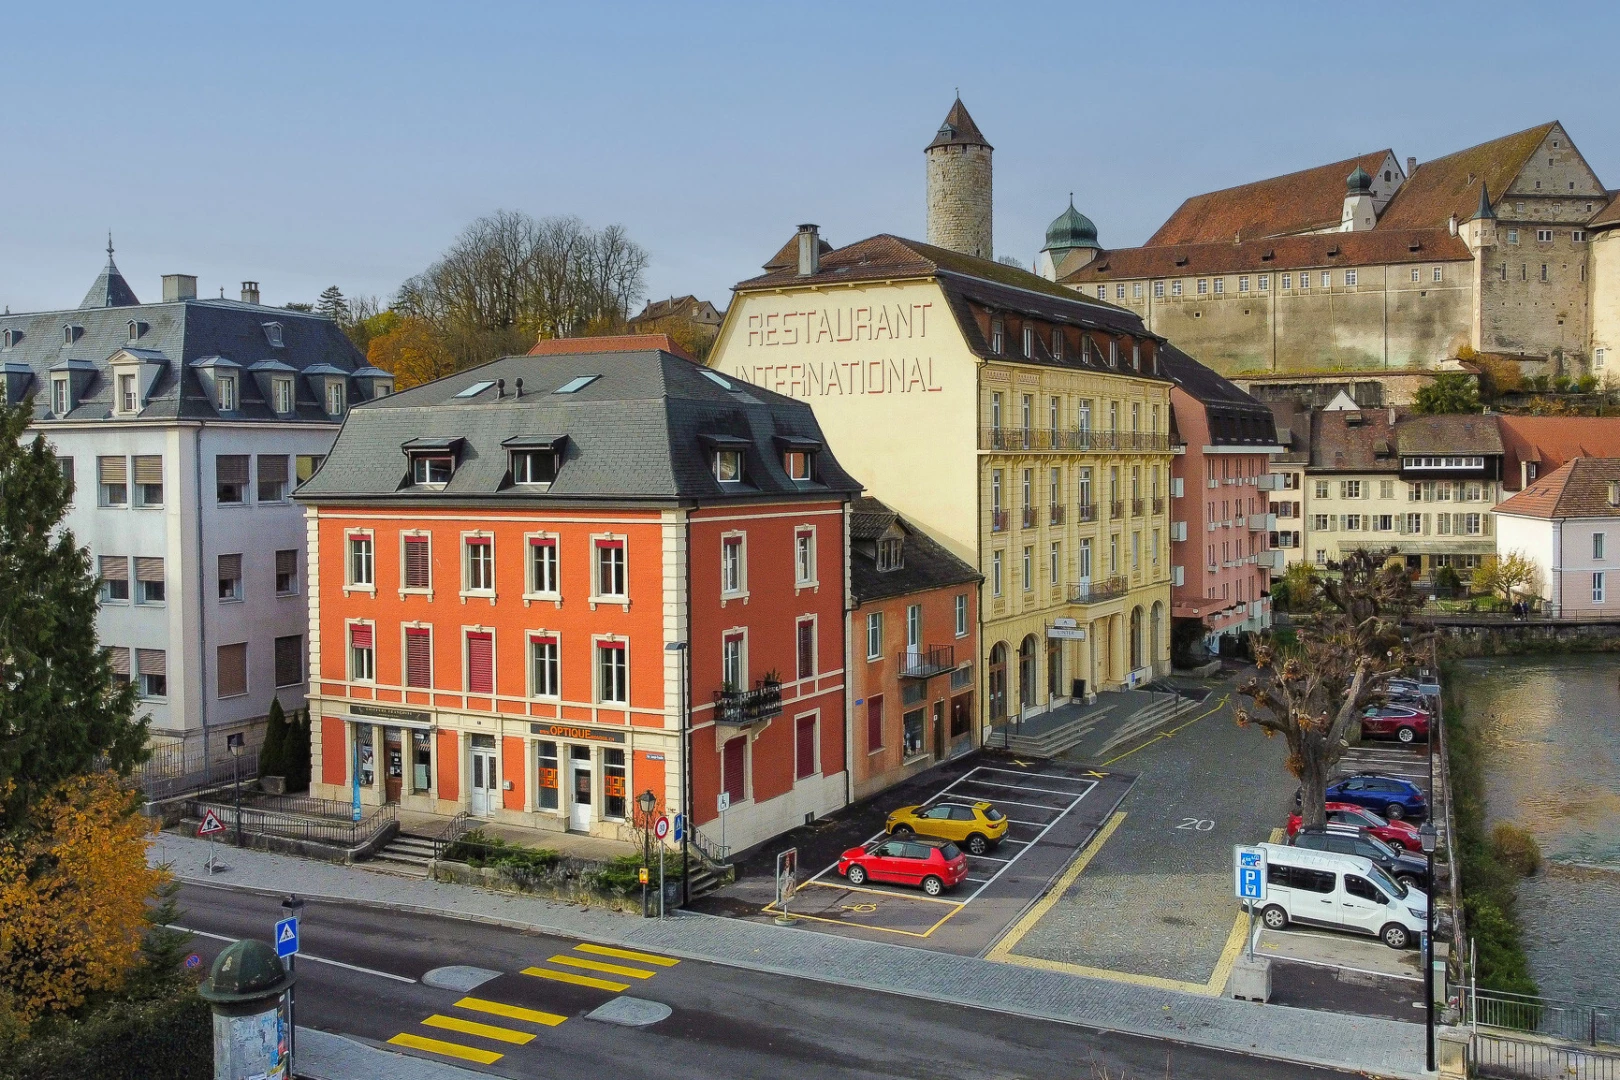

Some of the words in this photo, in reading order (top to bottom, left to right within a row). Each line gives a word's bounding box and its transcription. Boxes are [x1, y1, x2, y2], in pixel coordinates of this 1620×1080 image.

[748, 302, 933, 347] RESTAURANT
[1175, 817, 1215, 831] 20
[1245, 870, 1256, 884] P
